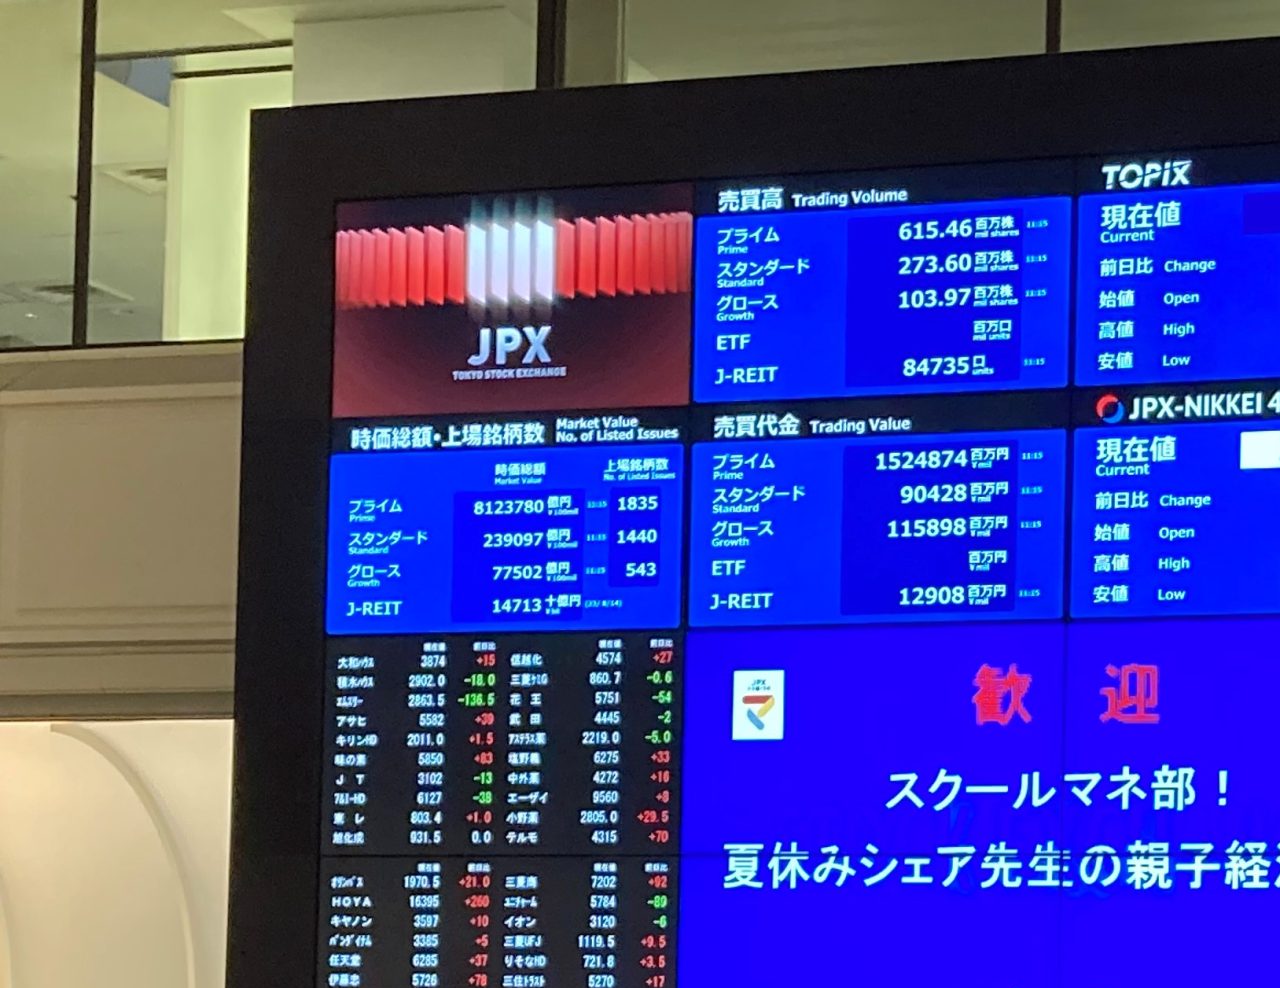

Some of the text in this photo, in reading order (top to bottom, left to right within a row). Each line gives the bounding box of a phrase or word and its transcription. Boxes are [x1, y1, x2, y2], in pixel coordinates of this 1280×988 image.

[718, 187, 908, 213] 売買高 Trading Volume
[1100, 200, 1182, 230] 現在値
[717, 215, 1014, 245] プライム 615.46 百万株
[1099, 229, 1155, 244] Current
[717, 245, 749, 255] Prime
[716, 253, 973, 278] スタンダード 273.60
[1099, 256, 1154, 277] 前日比
[1163, 259, 1217, 273] Change
[716, 276, 765, 289] Standard
[716, 287, 972, 312] グロース 103.97
[1099, 289, 1135, 309] 始値
[1163, 292, 1200, 306] Open
[715, 310, 755, 322] Growth
[1098, 321, 1134, 340] 高値
[1163, 322, 1195, 337] High
[467, 325, 552, 366] JPX
[716, 333, 751, 351] ETF
[714, 356, 970, 385] J-REIT 84735
[1097, 352, 1134, 371] 安値
[1162, 354, 1191, 367] Low
[1128, 391, 1263, 421] JPX-NIKKEI
[555, 415, 639, 430] Market Value
[713, 413, 912, 439] 売買代金 Trading Value
[555, 427, 679, 443] No. of Listed Issues
[712, 446, 1009, 471] プライム 1524874 百万円
[1096, 435, 1177, 464] 現在値
[494, 457, 669, 477] 時価総額 上場銘柄数
[712, 470, 744, 481] Prime
[1095, 463, 1150, 477] Current
[712, 483, 968, 505] スタンダード 90428
[1095, 490, 1149, 510] 前日比
[1159, 494, 1212, 509] Change
[349, 495, 658, 516] プライム 8123780 1835
[348, 528, 658, 548] スタンダード 239097 1440
[711, 517, 967, 539] グロース 115898
[1094, 523, 1130, 542] 始値
[1158, 526, 1195, 541] Open
[347, 562, 657, 581] グロース 77502 543
[711, 559, 746, 576] ETF
[1093, 554, 1130, 573] 高値
[1158, 556, 1191, 571] High
[709, 585, 965, 610] J-REIT 12908
[1092, 584, 1129, 603] 安値
[1157, 588, 1186, 601] Low
[346, 597, 542, 617] J-REIT 14713
[595, 652, 622, 665] 4574
[594, 691, 620, 705] 5751
[971, 662, 1160, 726] 歓 迎
[593, 750, 620, 764] 6275
[885, 764, 1228, 812] スクールマネ部！
[591, 829, 618, 844] 4315
[413, 914, 439, 928] 3597
